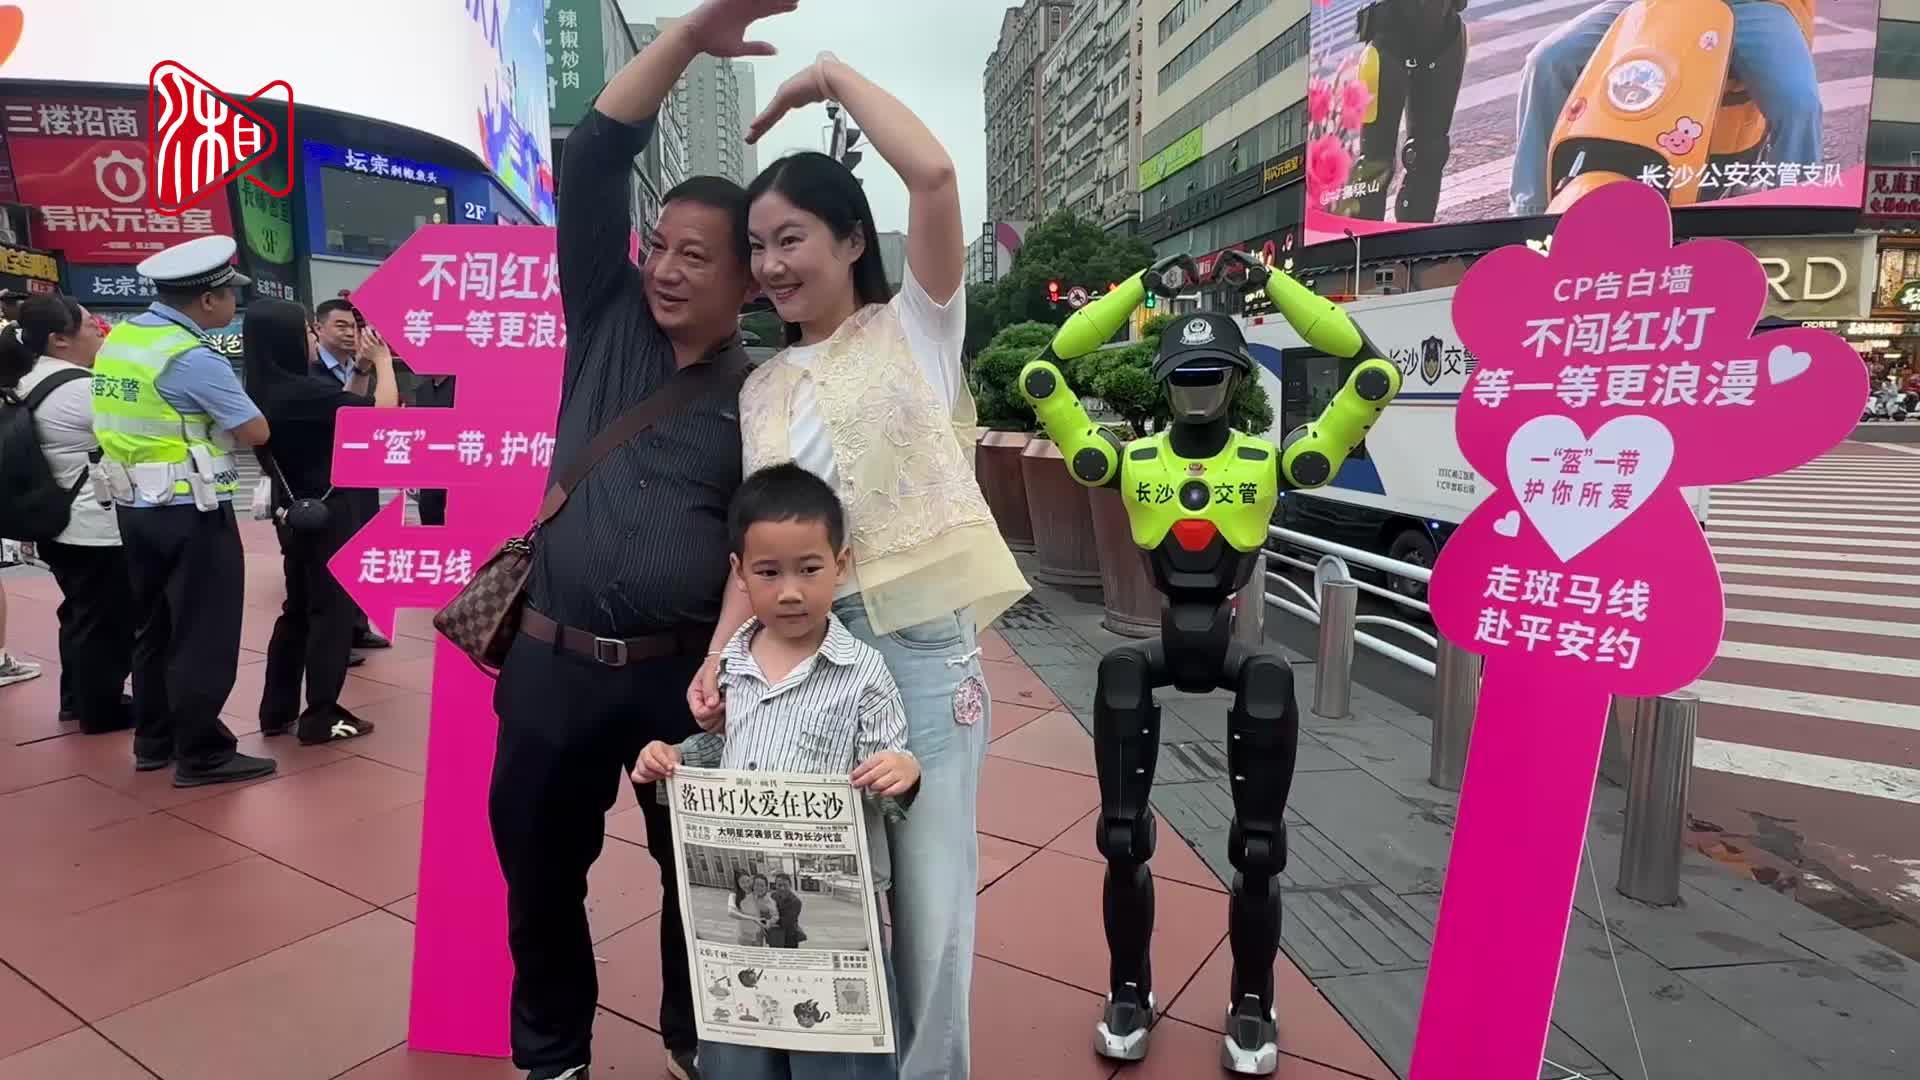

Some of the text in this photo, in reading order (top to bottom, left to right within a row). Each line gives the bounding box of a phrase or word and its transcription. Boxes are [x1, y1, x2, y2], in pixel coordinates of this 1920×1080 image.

[558, 9, 580, 89] 辣椒炒肉
[5, 104, 138, 137] 三楼招商
[1636, 161, 1844, 190] 长沙公安交管支队
[40, 205, 215, 234] 异次元密室
[464, 202, 487, 222] 2F
[1554, 264, 1694, 302] CP告白墙
[403, 309, 567, 349] 等一等更浪
[1521, 305, 1717, 358] 不闯红灯
[1472, 359, 1760, 409] 等一等更浪漫
[1135, 481, 1258, 505] 长沙 交管
[1523, 478, 1633, 511] 护你所爱
[358, 548, 473, 585] 走斑马线
[1483, 563, 1651, 623] 走斑马线
[1473, 607, 1642, 670] 赴平安约
[681, 783, 845, 820] 落日灯火爱在长沙
